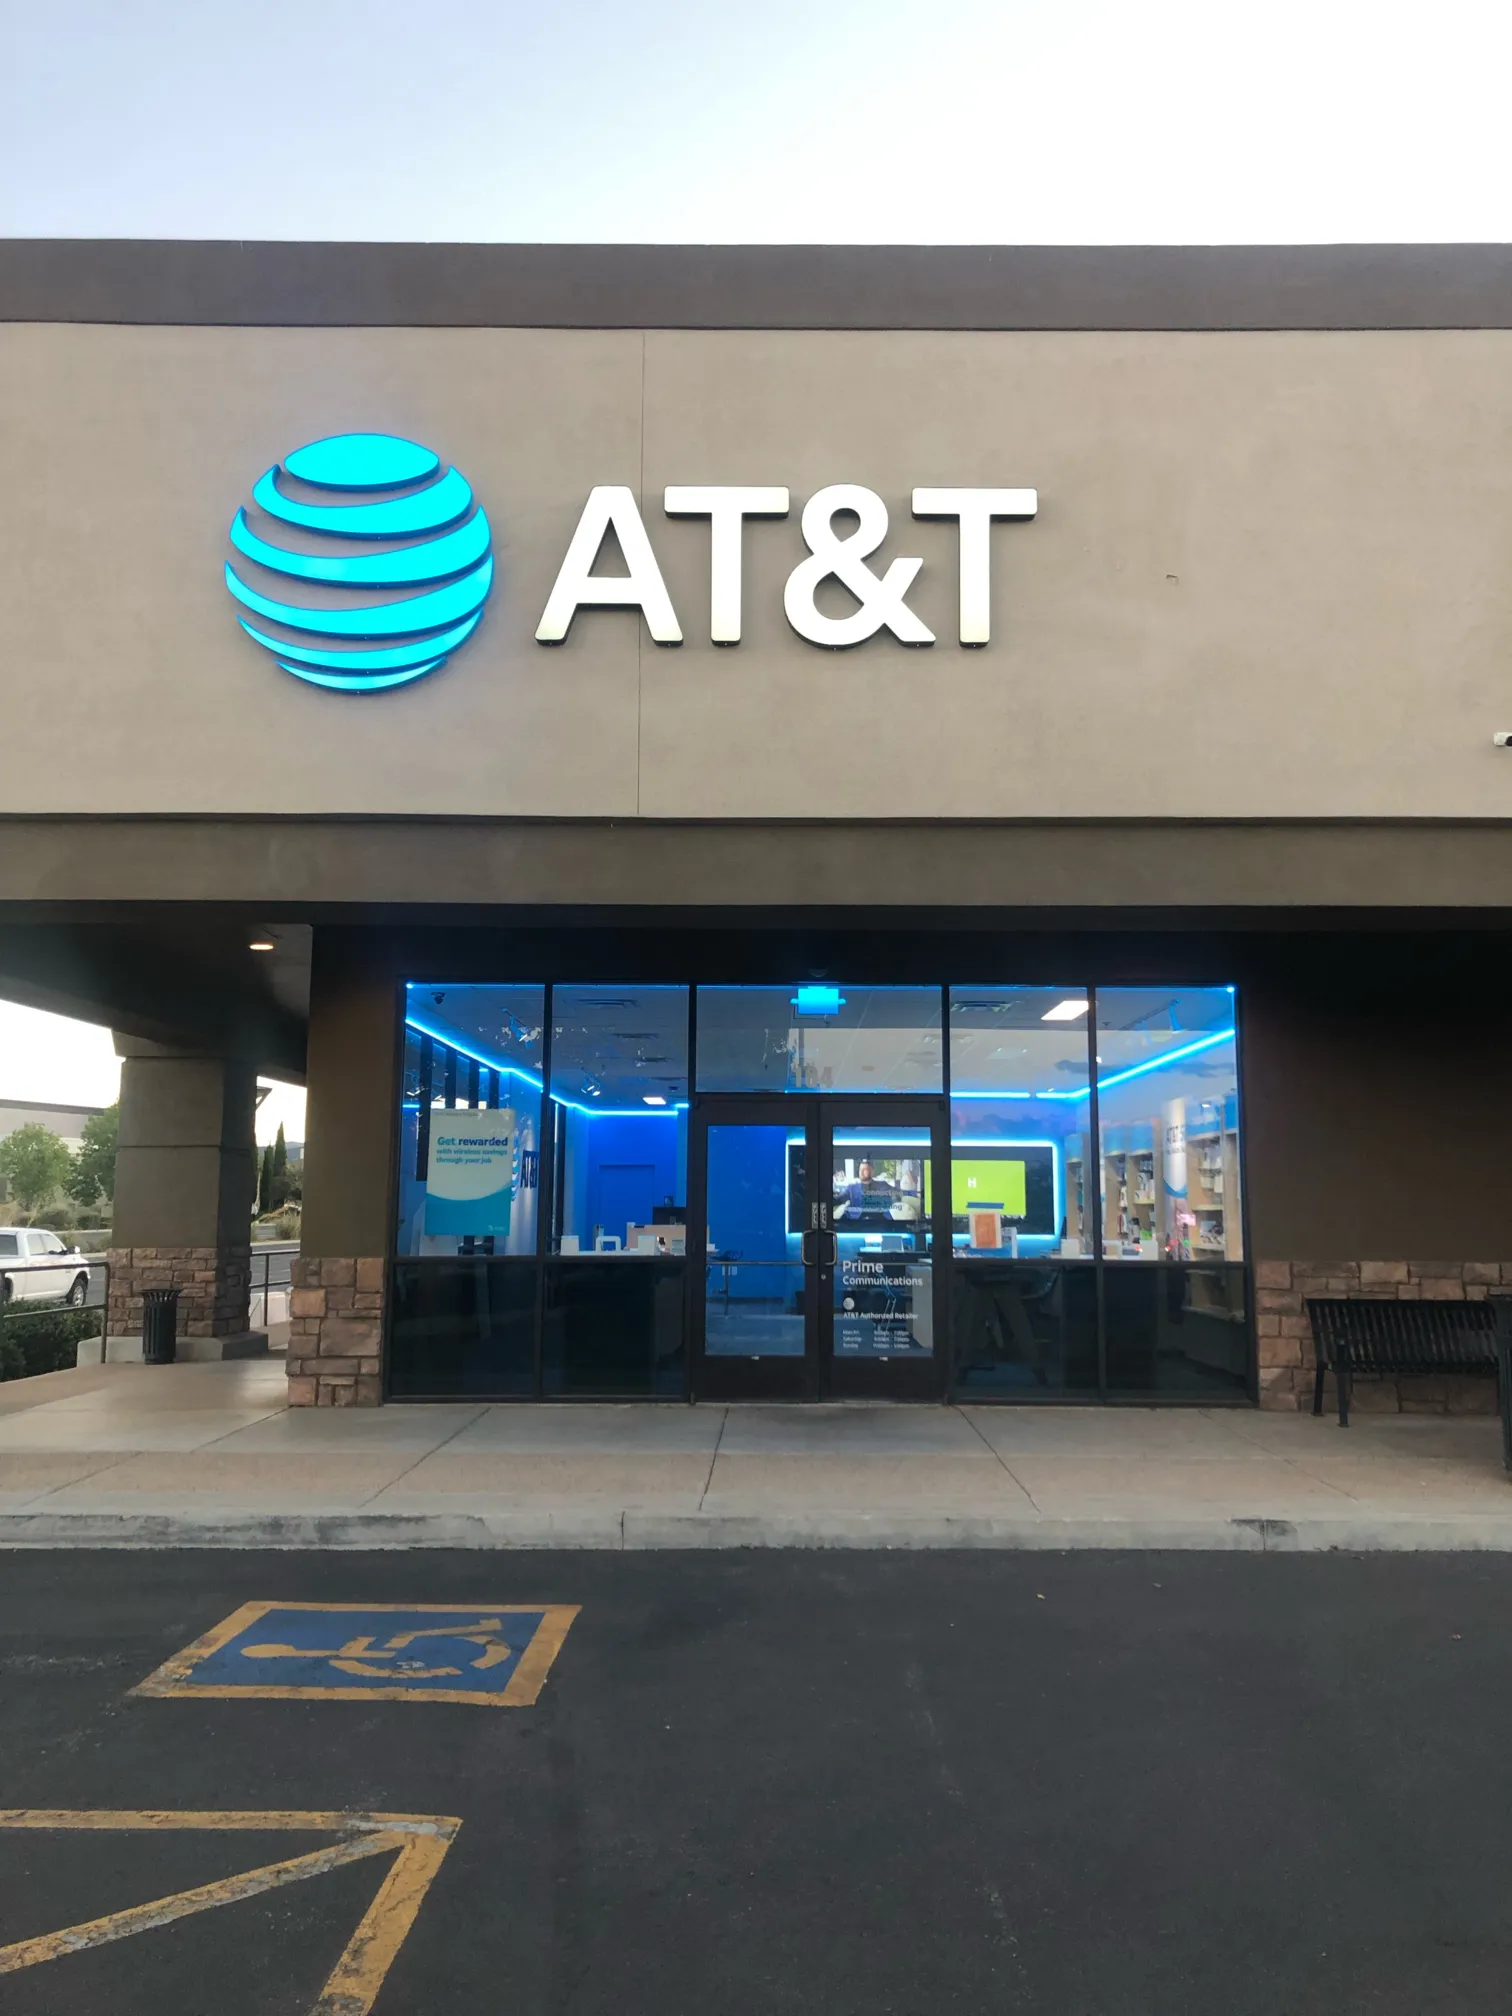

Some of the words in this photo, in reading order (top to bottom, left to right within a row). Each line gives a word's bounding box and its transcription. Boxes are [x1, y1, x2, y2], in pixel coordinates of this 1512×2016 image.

[535, 484, 1037, 649] AT&T
[437, 1136, 456, 1146] Get
[458, 1137, 508, 1146] rewarded
[481, 1157, 492, 1165] job
[842, 1260, 884, 1273] Prime
[842, 1275, 923, 1286] Communications
